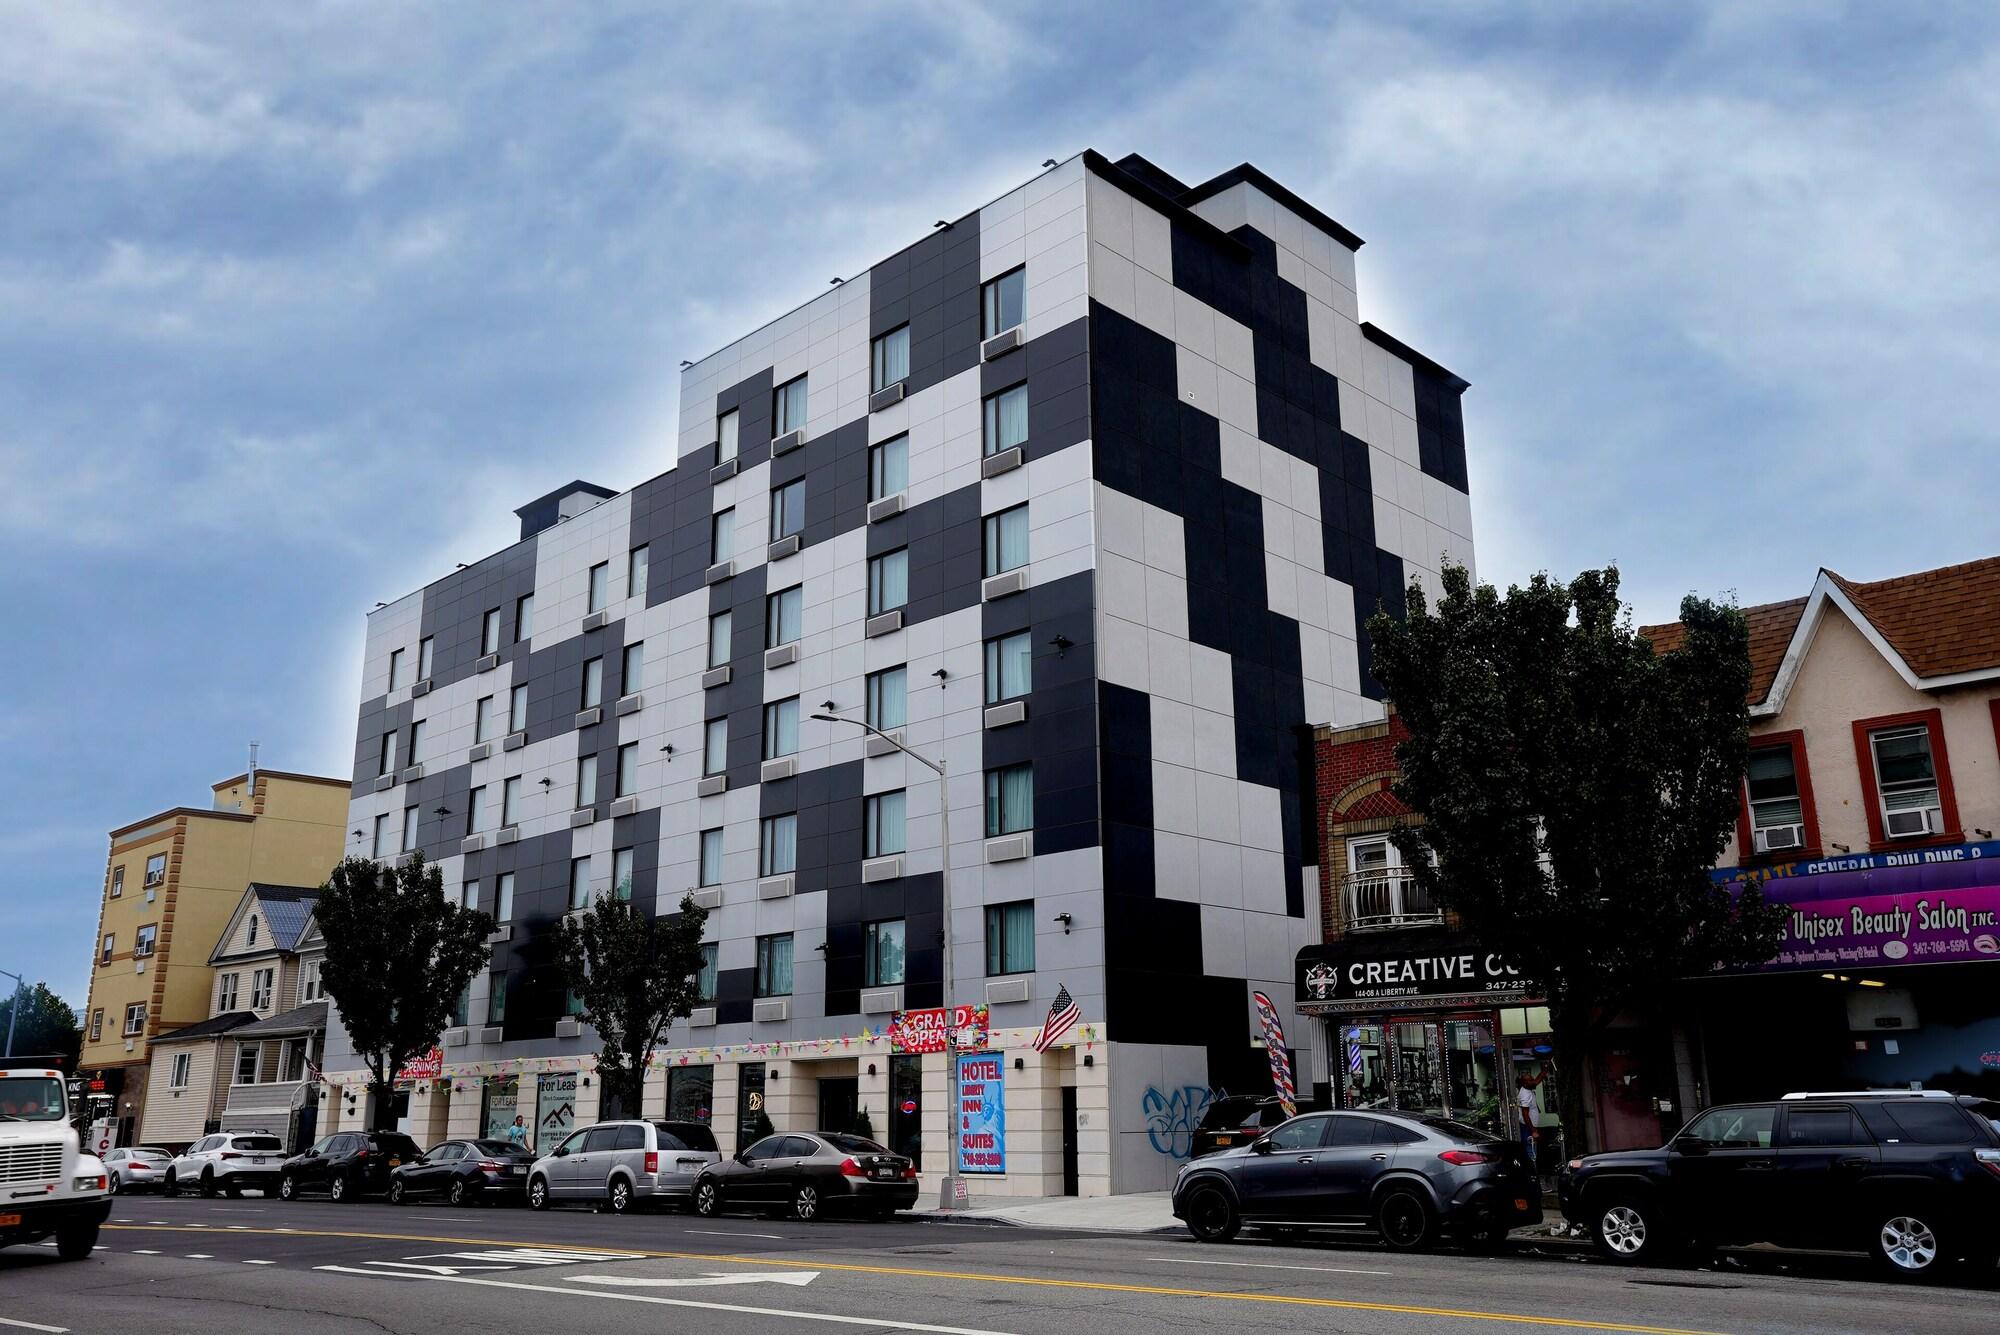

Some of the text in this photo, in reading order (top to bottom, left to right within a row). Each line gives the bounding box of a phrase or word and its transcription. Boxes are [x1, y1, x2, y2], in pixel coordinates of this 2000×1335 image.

[1792, 911, 1843, 944] Unisex
[1851, 904, 1911, 939] Beauty
[1917, 900, 1970, 934] Salon
[1972, 912, 1999, 926] INC.
[1348, 954, 1475, 985] CREATIVE
[1376, 989, 1380, 997] A
[1381, 987, 1406, 996] LIBERTY
[914, 1010, 967, 1030] GRAD
[961, 1061, 1002, 1081] HOTEL
[557, 1079, 577, 1091] Leas
[962, 1100, 982, 1112] INN
[962, 1115, 970, 1130] &
[962, 1133, 994, 1149] SUITES
